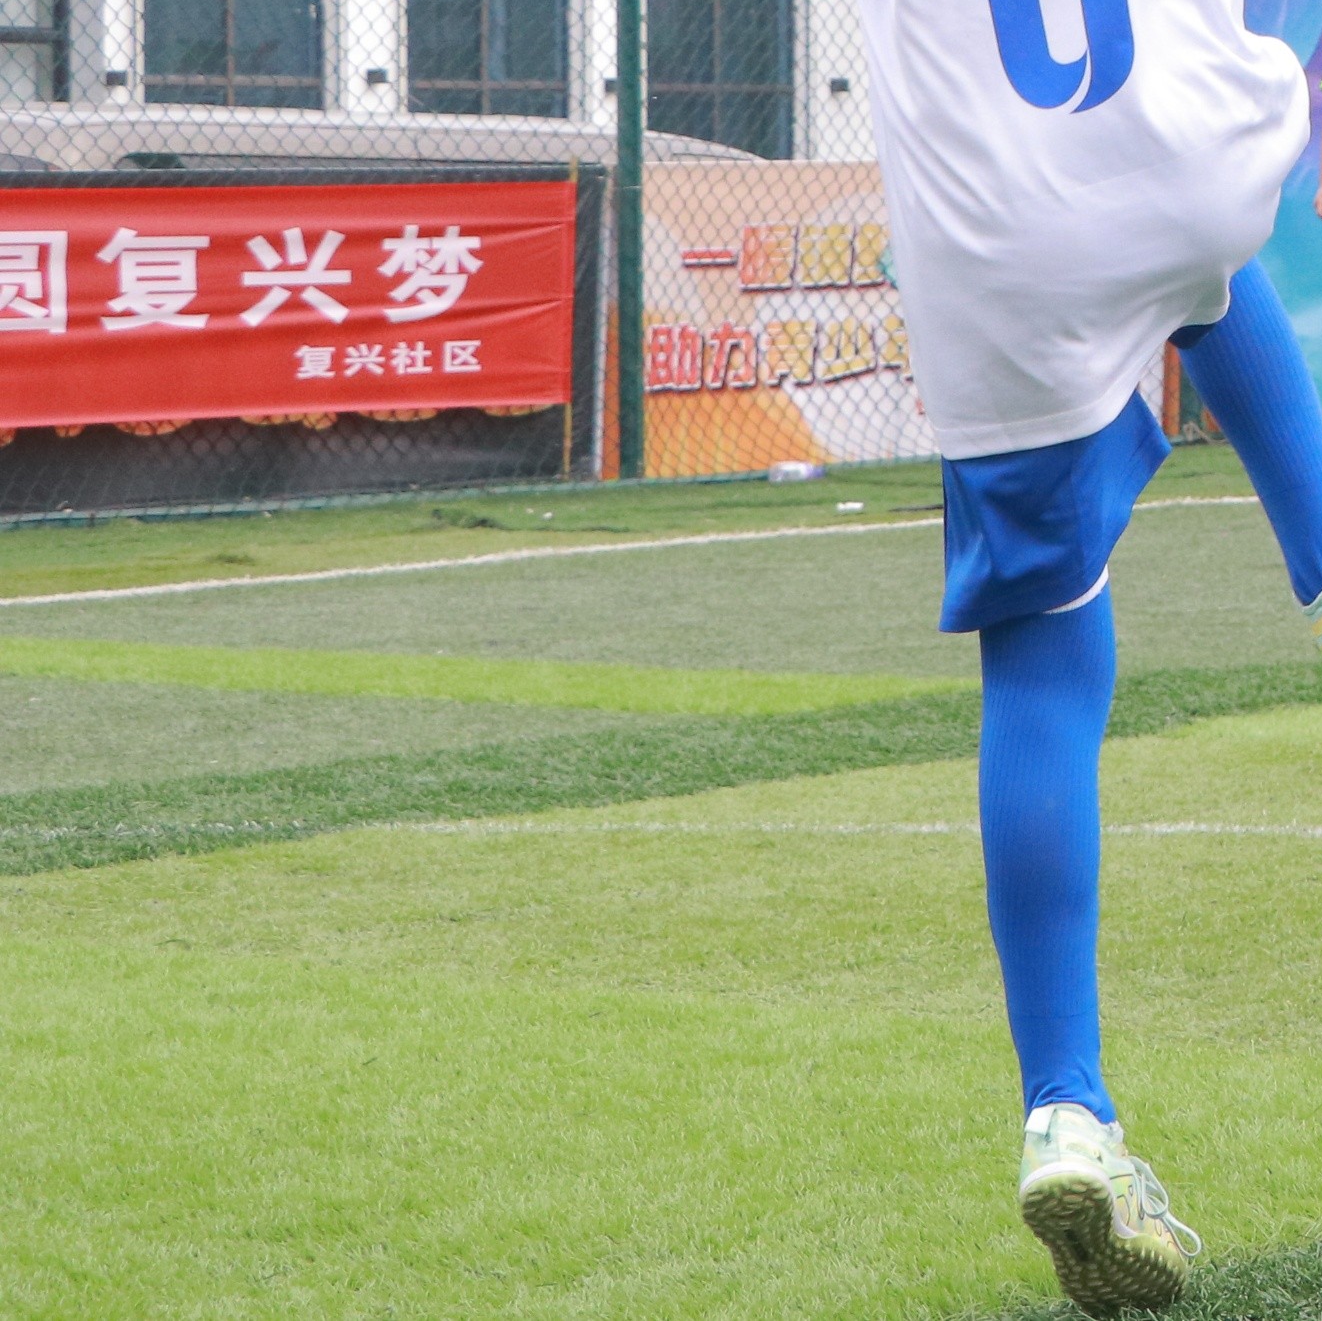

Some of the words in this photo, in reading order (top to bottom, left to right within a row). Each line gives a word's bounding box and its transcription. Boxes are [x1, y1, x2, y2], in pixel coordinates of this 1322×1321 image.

[0, 224, 483, 335] 圆复兴梦
[294, 338, 483, 379] 复兴社区
